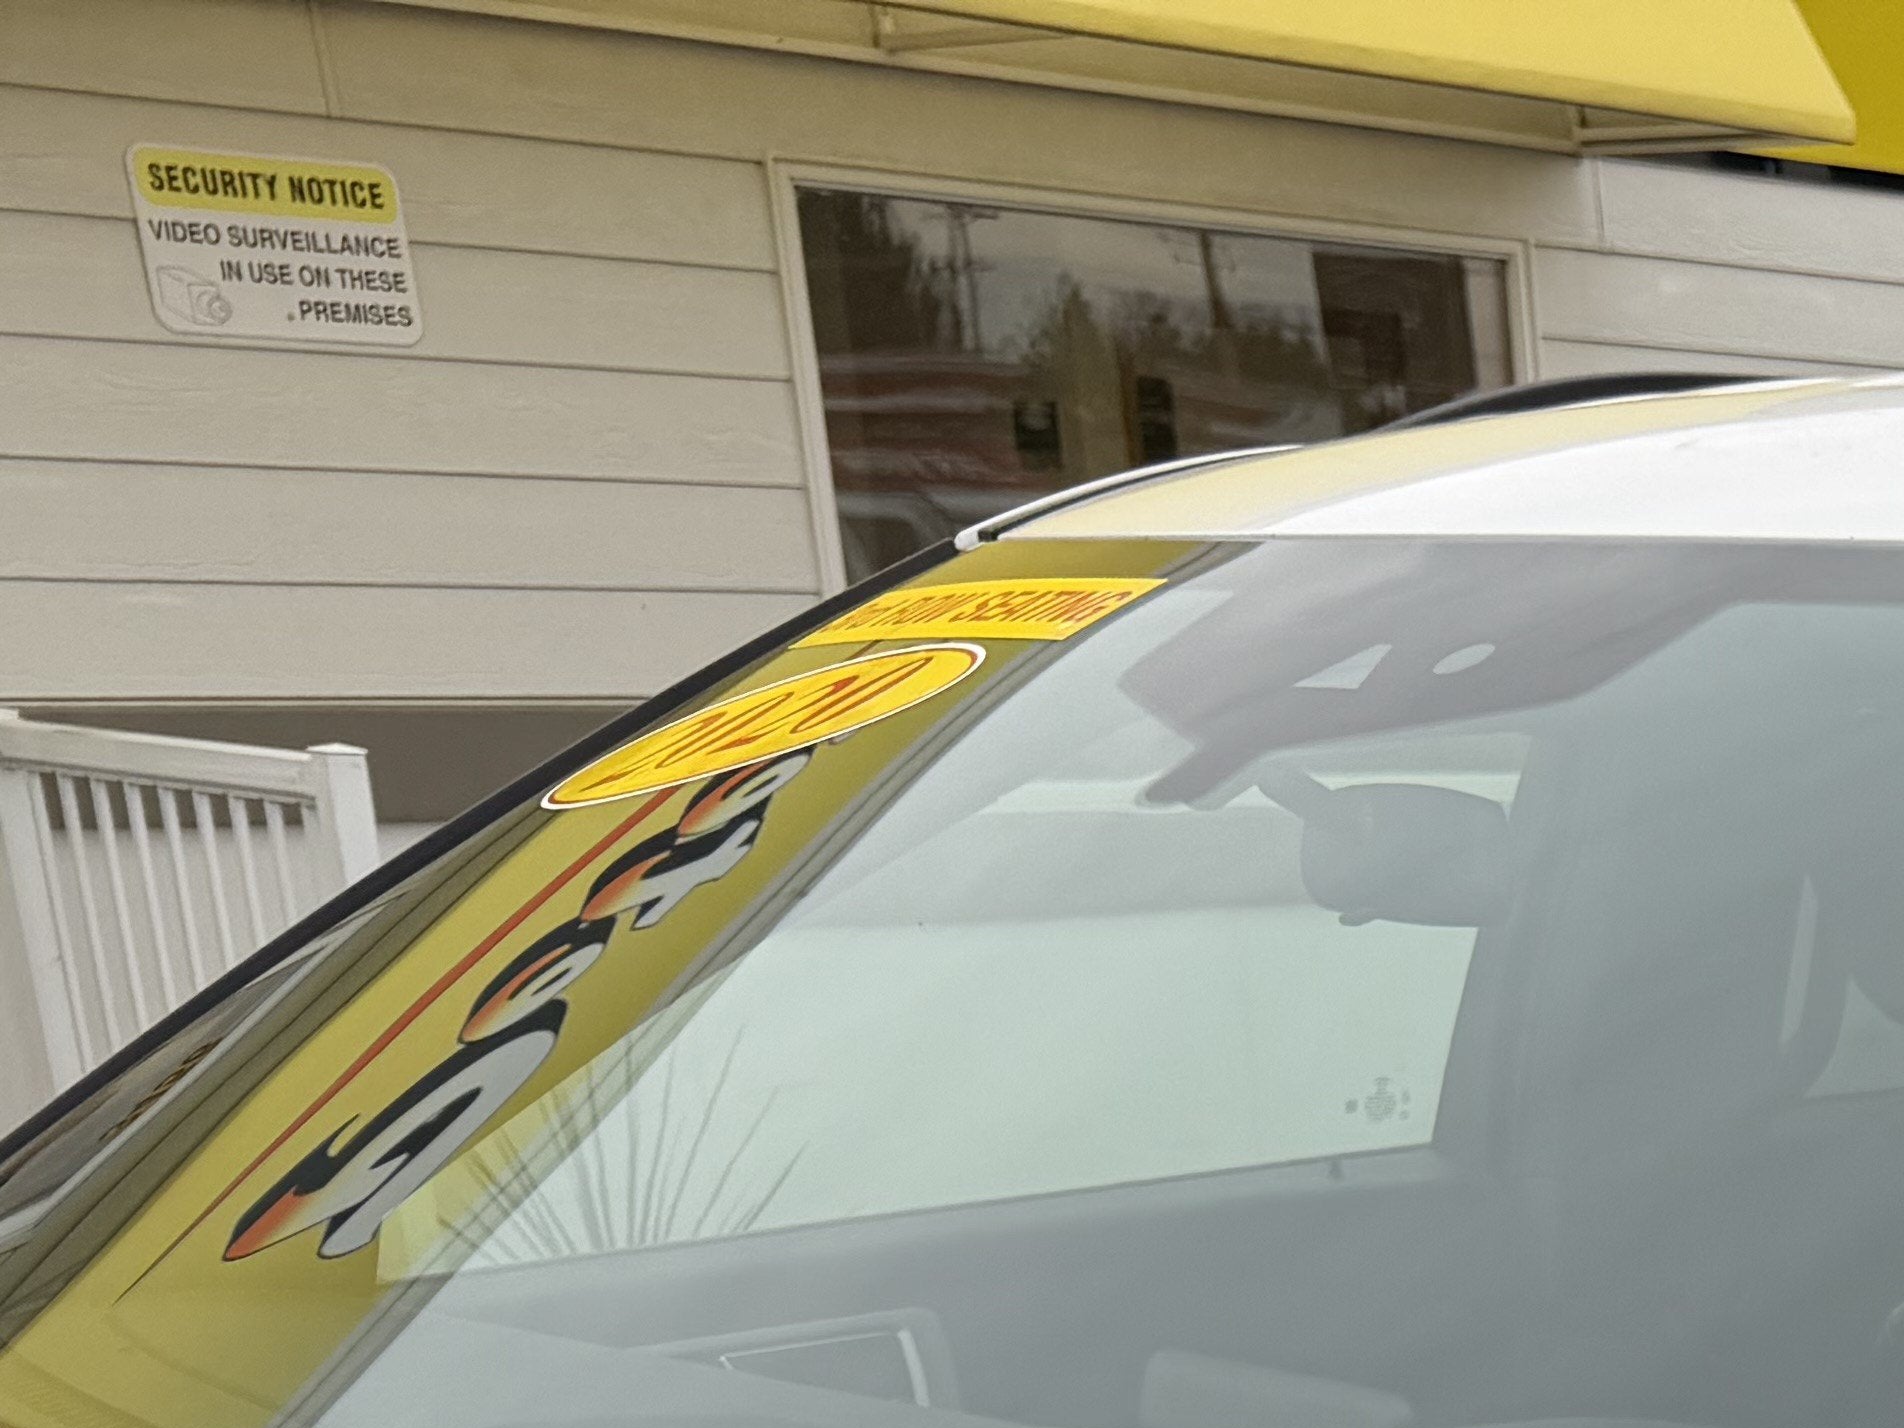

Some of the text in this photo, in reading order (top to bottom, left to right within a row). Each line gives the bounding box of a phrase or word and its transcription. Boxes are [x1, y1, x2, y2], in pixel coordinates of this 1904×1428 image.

[148, 162, 385, 210] SECURITY NOTICE
[148, 219, 402, 259] VIDEO SURVEILLANCE
[220, 260, 408, 293] IN USE ON THESE
[298, 299, 413, 327] PREMISES
[948, 590, 1133, 624] SEATING
[580, 656, 935, 793] 2020
